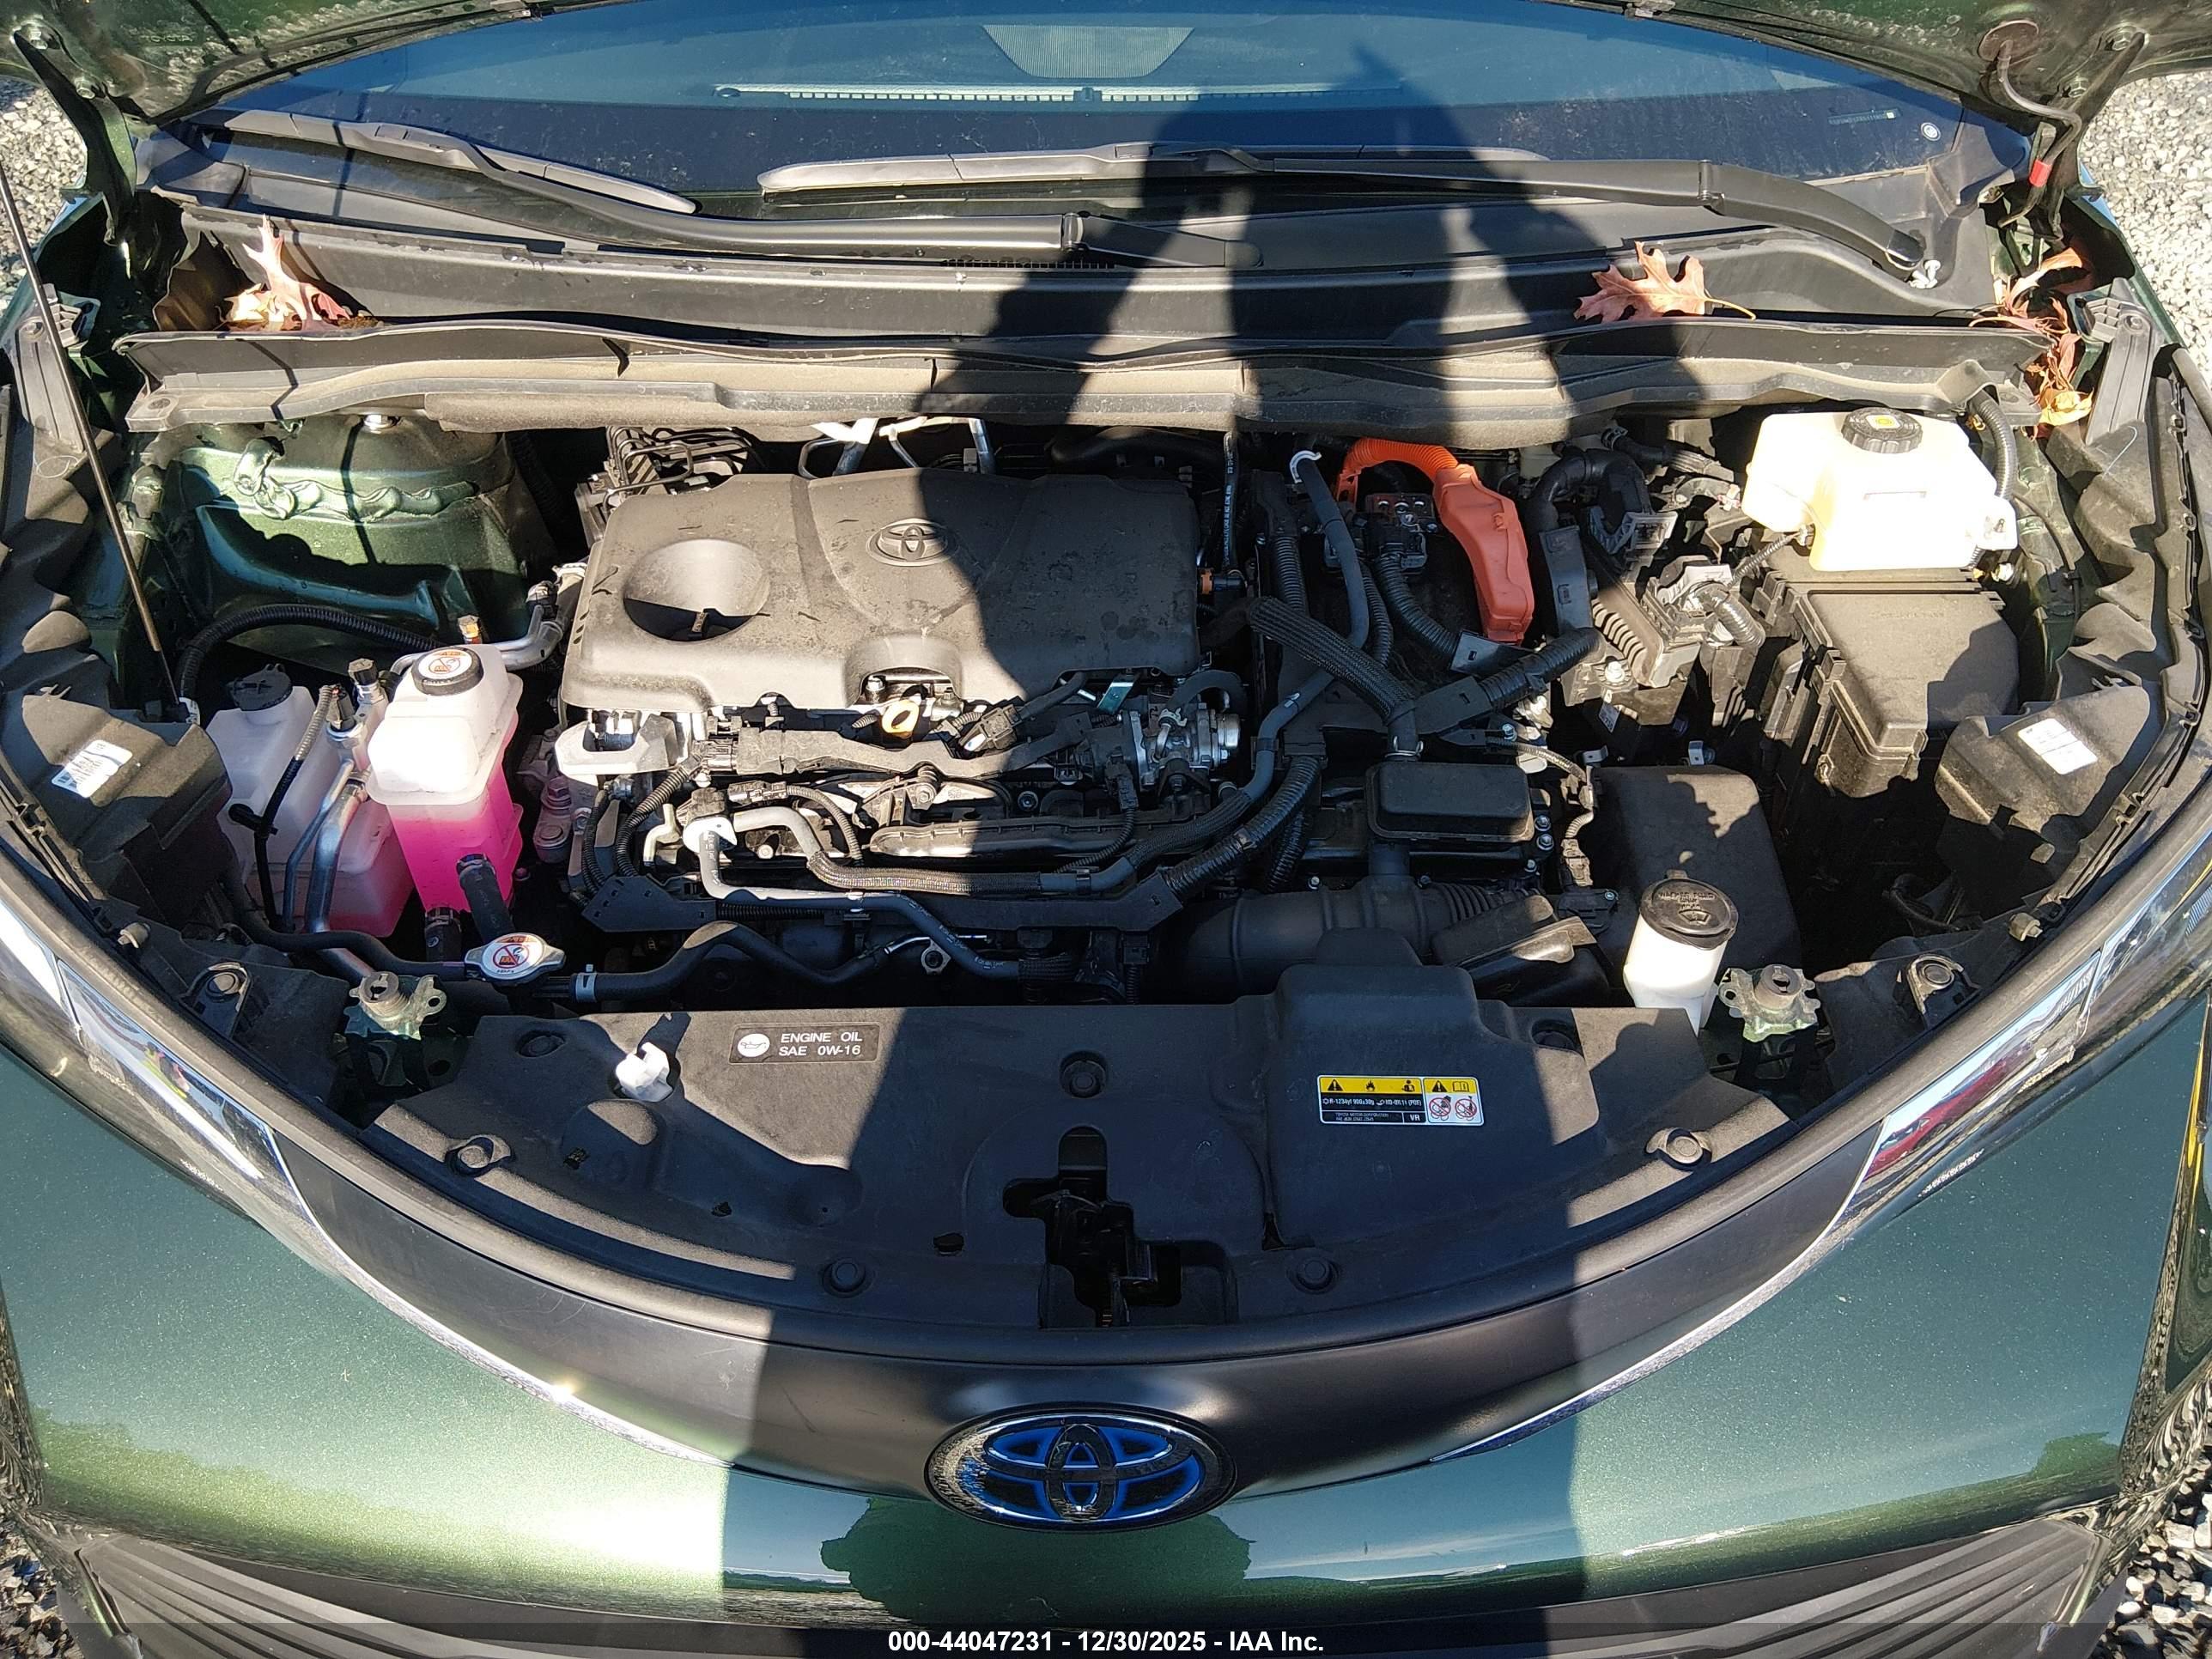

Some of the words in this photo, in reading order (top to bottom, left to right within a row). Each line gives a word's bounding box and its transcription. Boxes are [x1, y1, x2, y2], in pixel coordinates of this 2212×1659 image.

[781, 1032, 832, 1043] ENGINE
[840, 1031, 863, 1042] OIL
[778, 1045, 808, 1056] SAE
[817, 1044, 861, 1056] 0W-16
